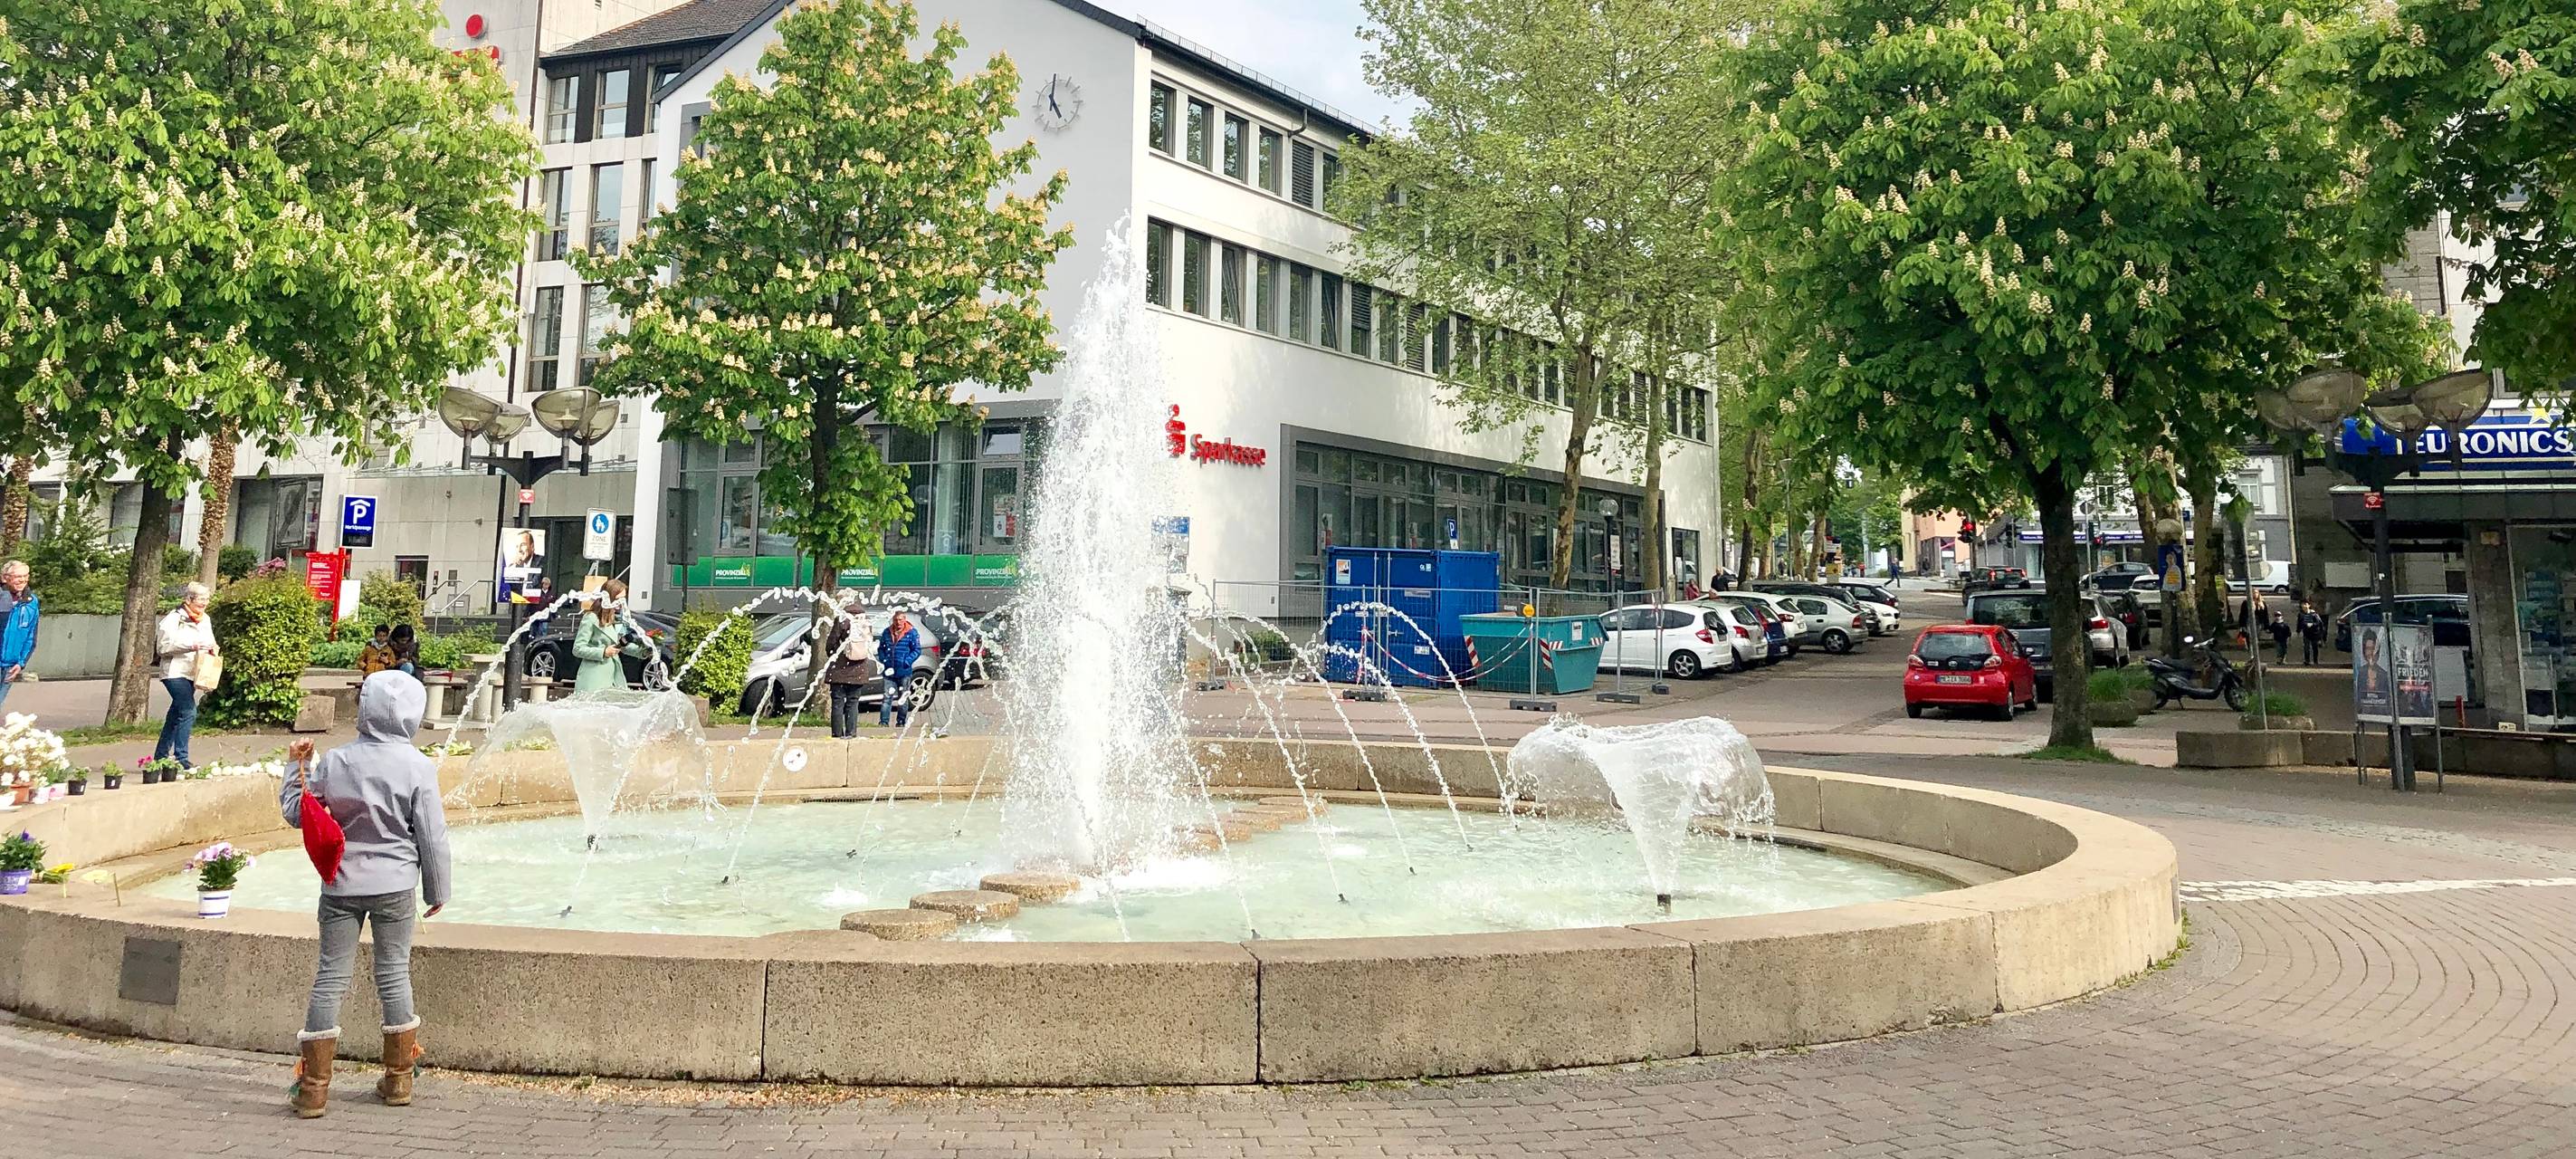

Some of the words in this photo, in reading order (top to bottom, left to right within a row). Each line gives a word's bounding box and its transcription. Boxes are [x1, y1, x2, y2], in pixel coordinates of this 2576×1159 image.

[1190, 433, 1266, 466] Sparkasse
[353, 504, 367, 524] P
[976, 568, 1013, 576] PROVINZIAL
[2398, 666, 2429, 678] FRIEDEN
